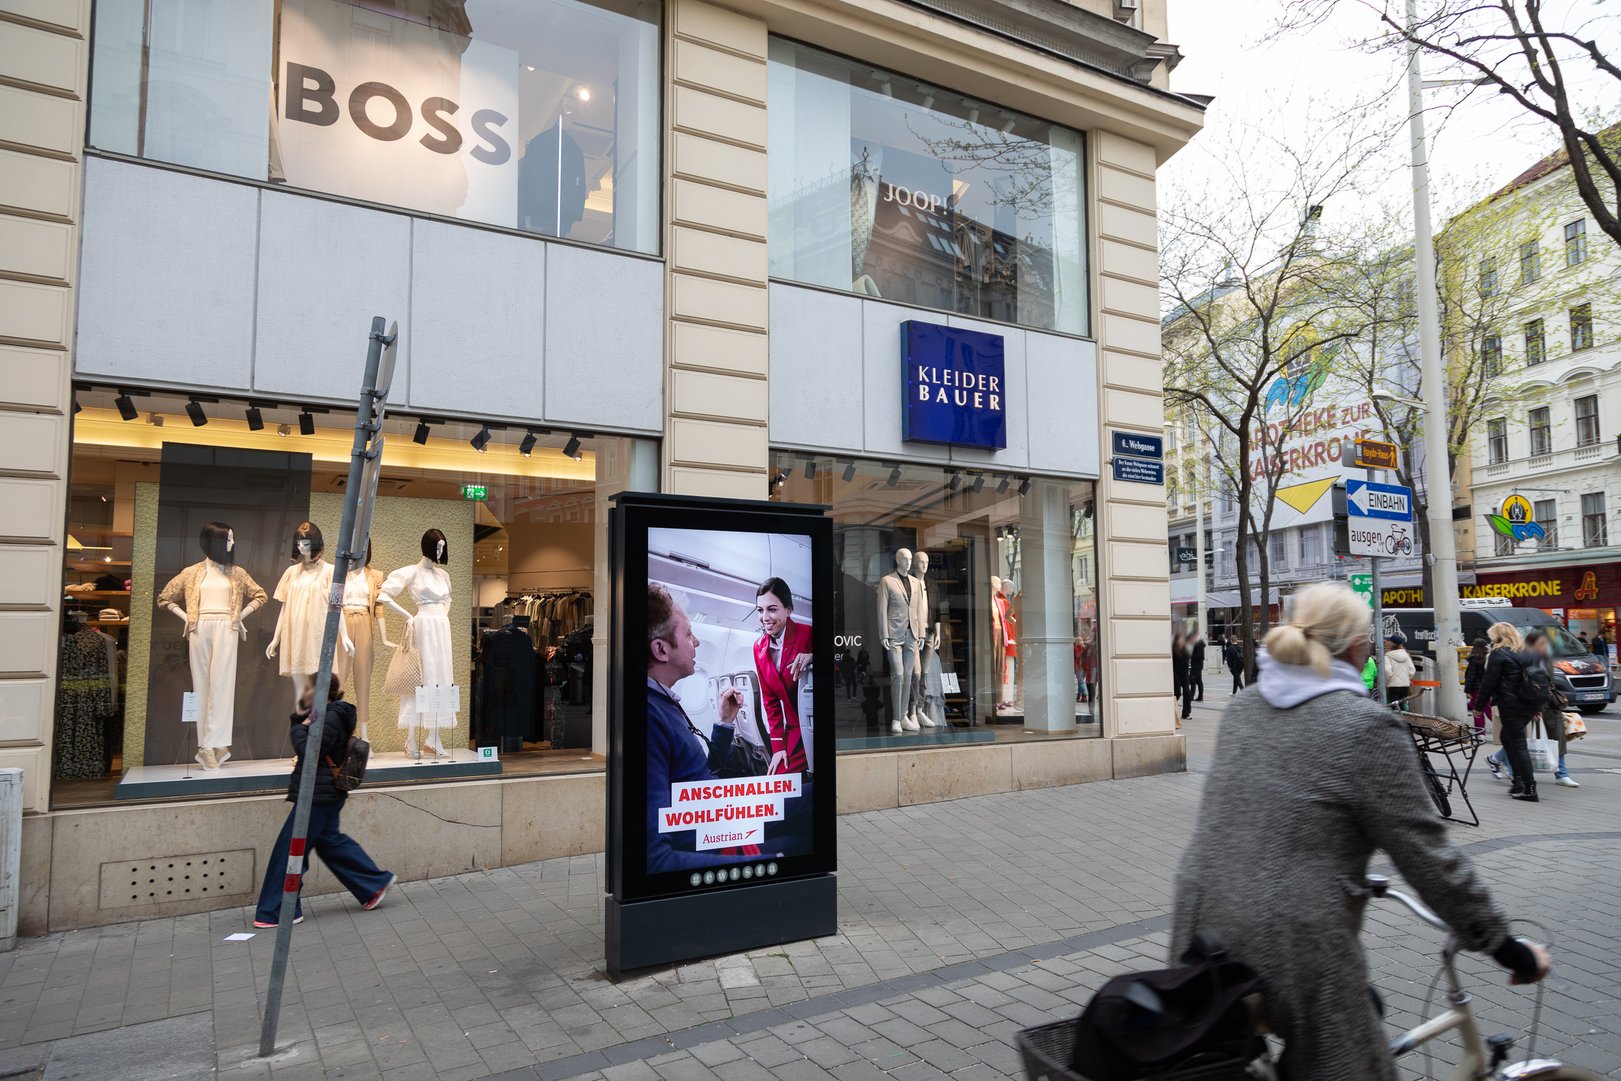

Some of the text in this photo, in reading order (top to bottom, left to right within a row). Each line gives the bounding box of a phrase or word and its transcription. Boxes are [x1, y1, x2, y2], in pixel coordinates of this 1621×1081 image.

[285, 61, 512, 165] BOSS
[883, 183, 948, 216] JOOP!
[919, 366, 999, 392] KLEIDER
[919, 384, 1000, 410] BAUER
[1341, 402, 1371, 426] ZUR
[1129, 440, 1155, 452] Webgasse
[1369, 493, 1405, 511] EINBAHN
[1463, 580, 1562, 599] KAISERKRONE
[679, 780, 796, 802] ANSCHNALLEN.
[666, 803, 779, 827] WOHLFÜHLEN.
[702, 831, 743, 844] Austrian
[691, 863, 777, 885] gewista
